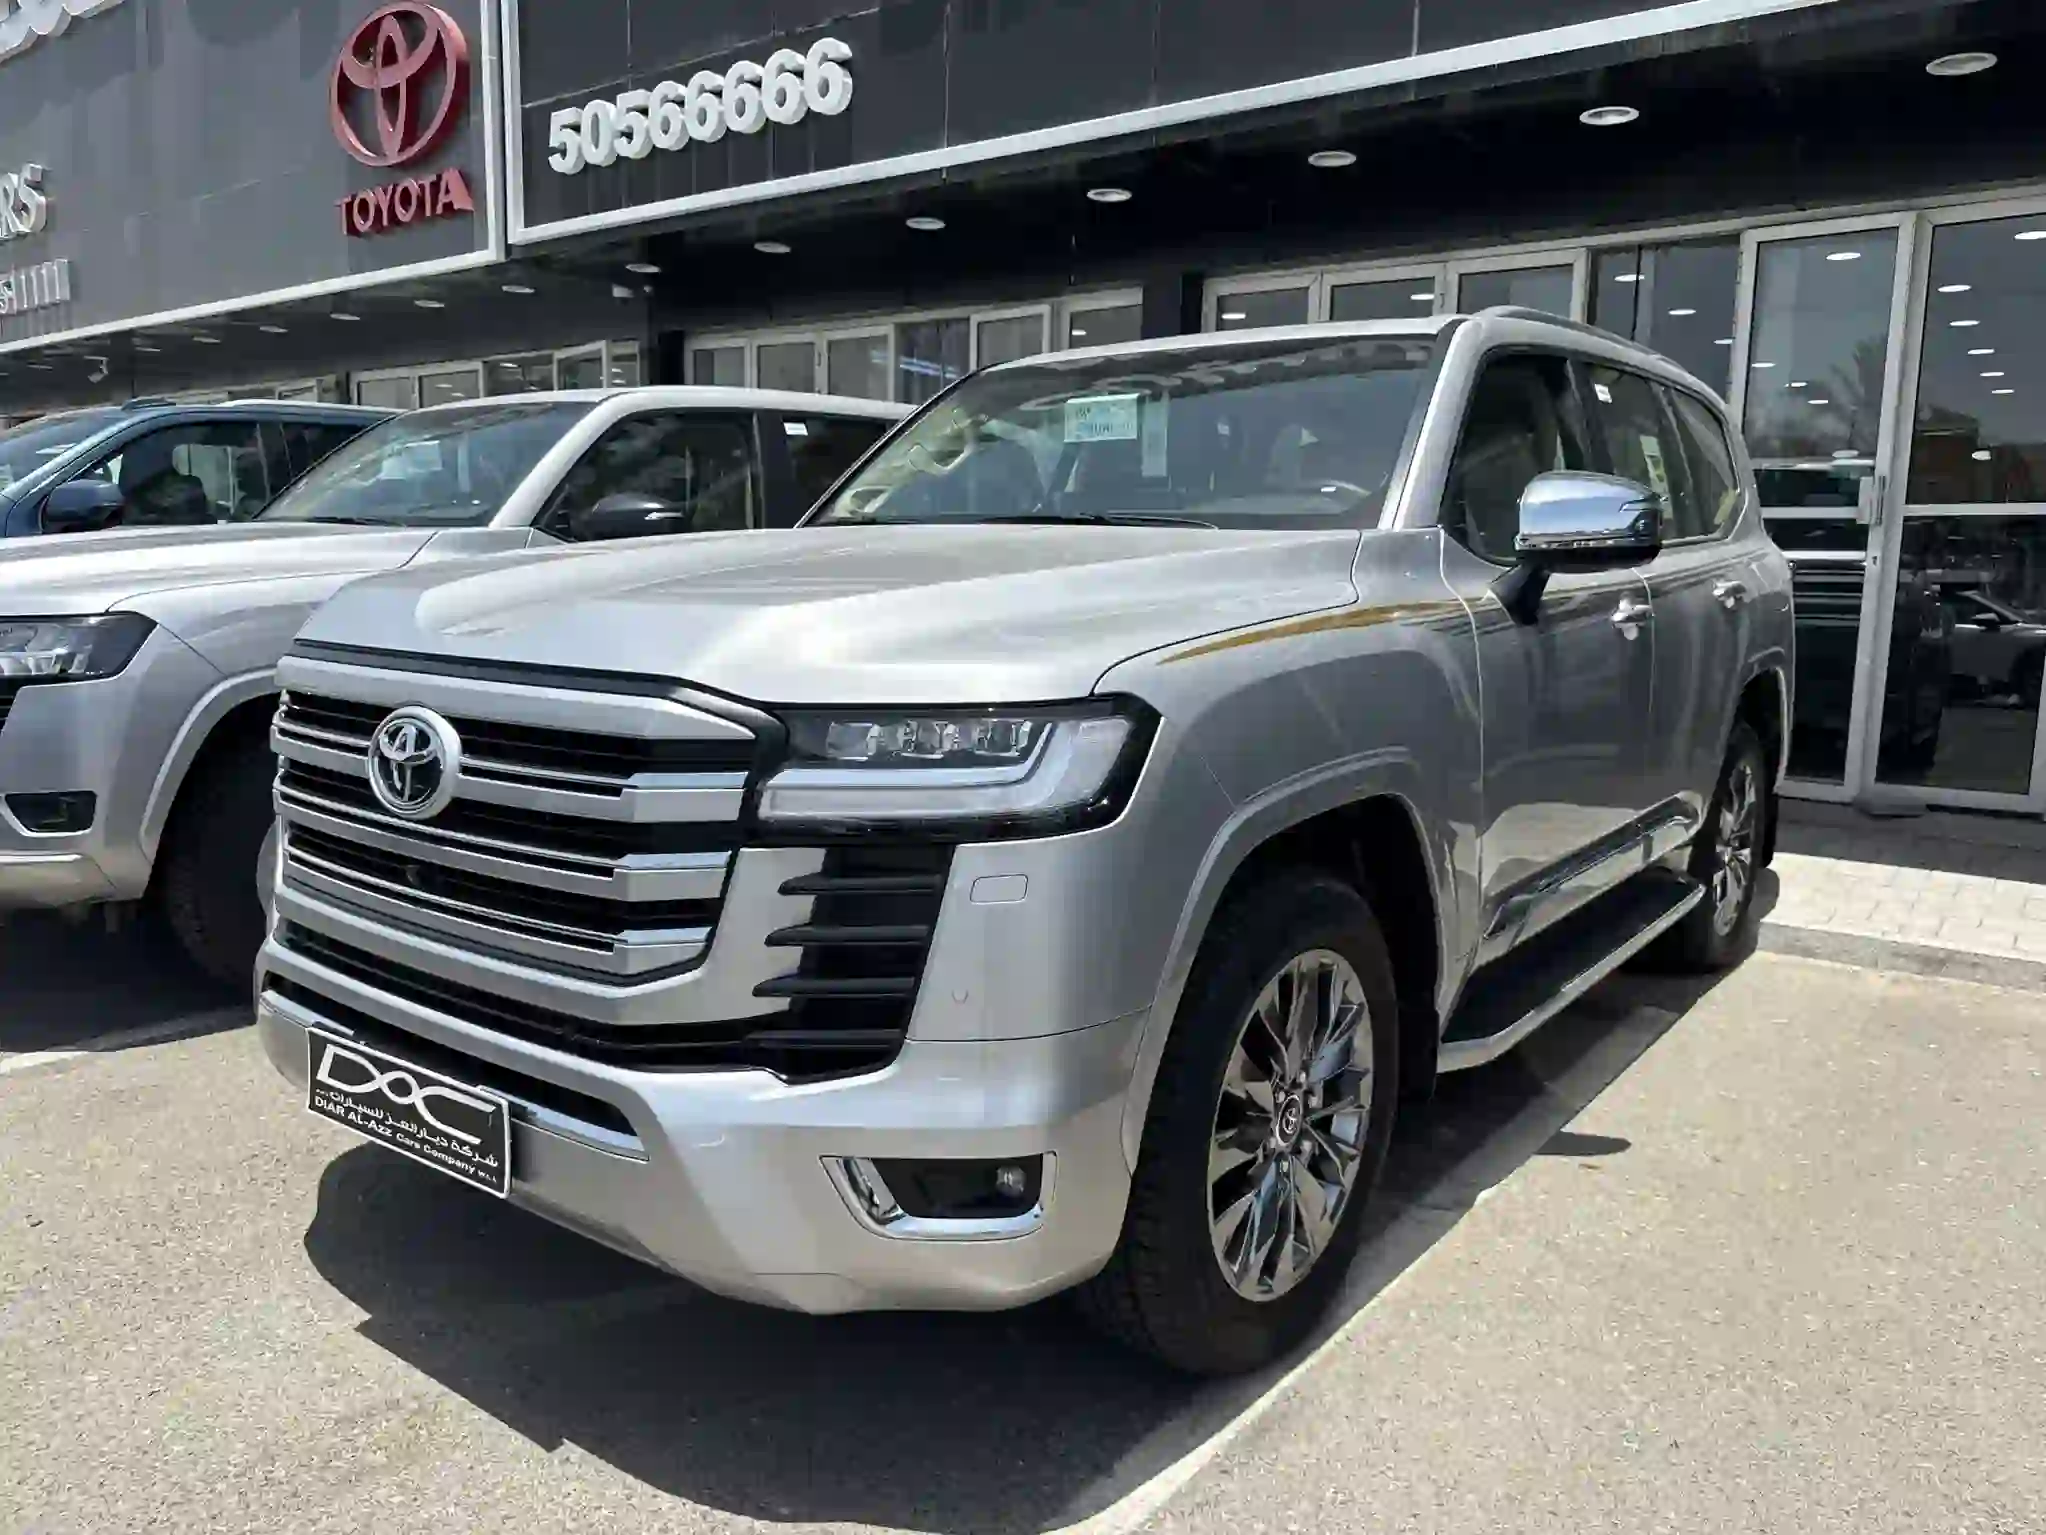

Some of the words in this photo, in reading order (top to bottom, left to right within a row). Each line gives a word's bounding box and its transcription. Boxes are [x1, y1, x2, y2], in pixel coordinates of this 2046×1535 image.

[548, 37, 853, 175] 50566666
[334, 167, 475, 236] TOYOTA
[314, 1095, 345, 1117] DIAR
[396, 1132, 421, 1149] Cars
[423, 1143, 476, 1174] Company
